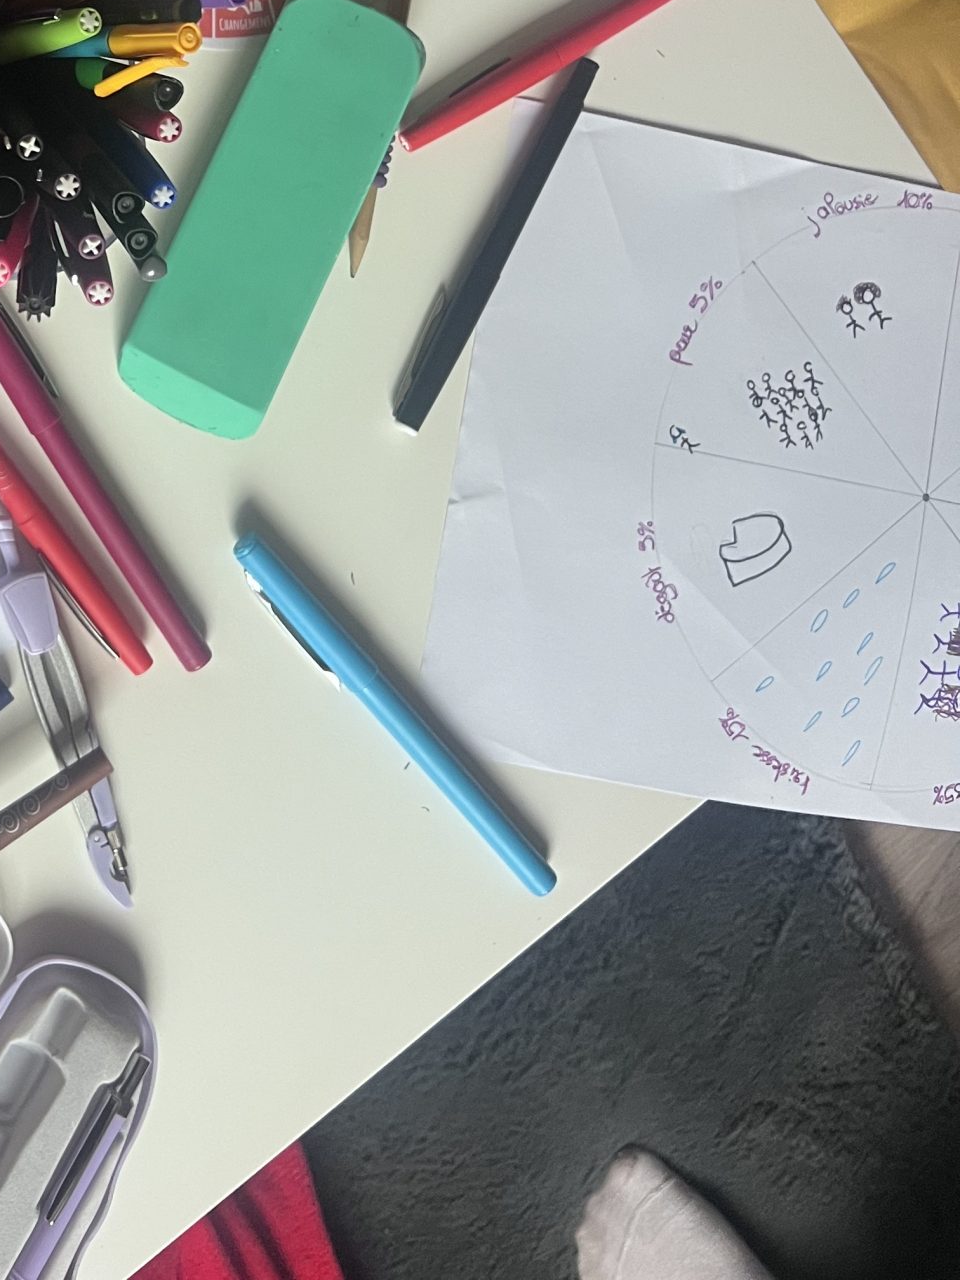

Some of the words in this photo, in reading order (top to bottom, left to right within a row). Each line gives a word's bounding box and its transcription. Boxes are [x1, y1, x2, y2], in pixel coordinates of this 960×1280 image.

[801, 191, 879, 238] jalousie
[897, 189, 935, 211] 10%
[688, 275, 724, 314] 5%
[637, 520, 656, 552] 5%
